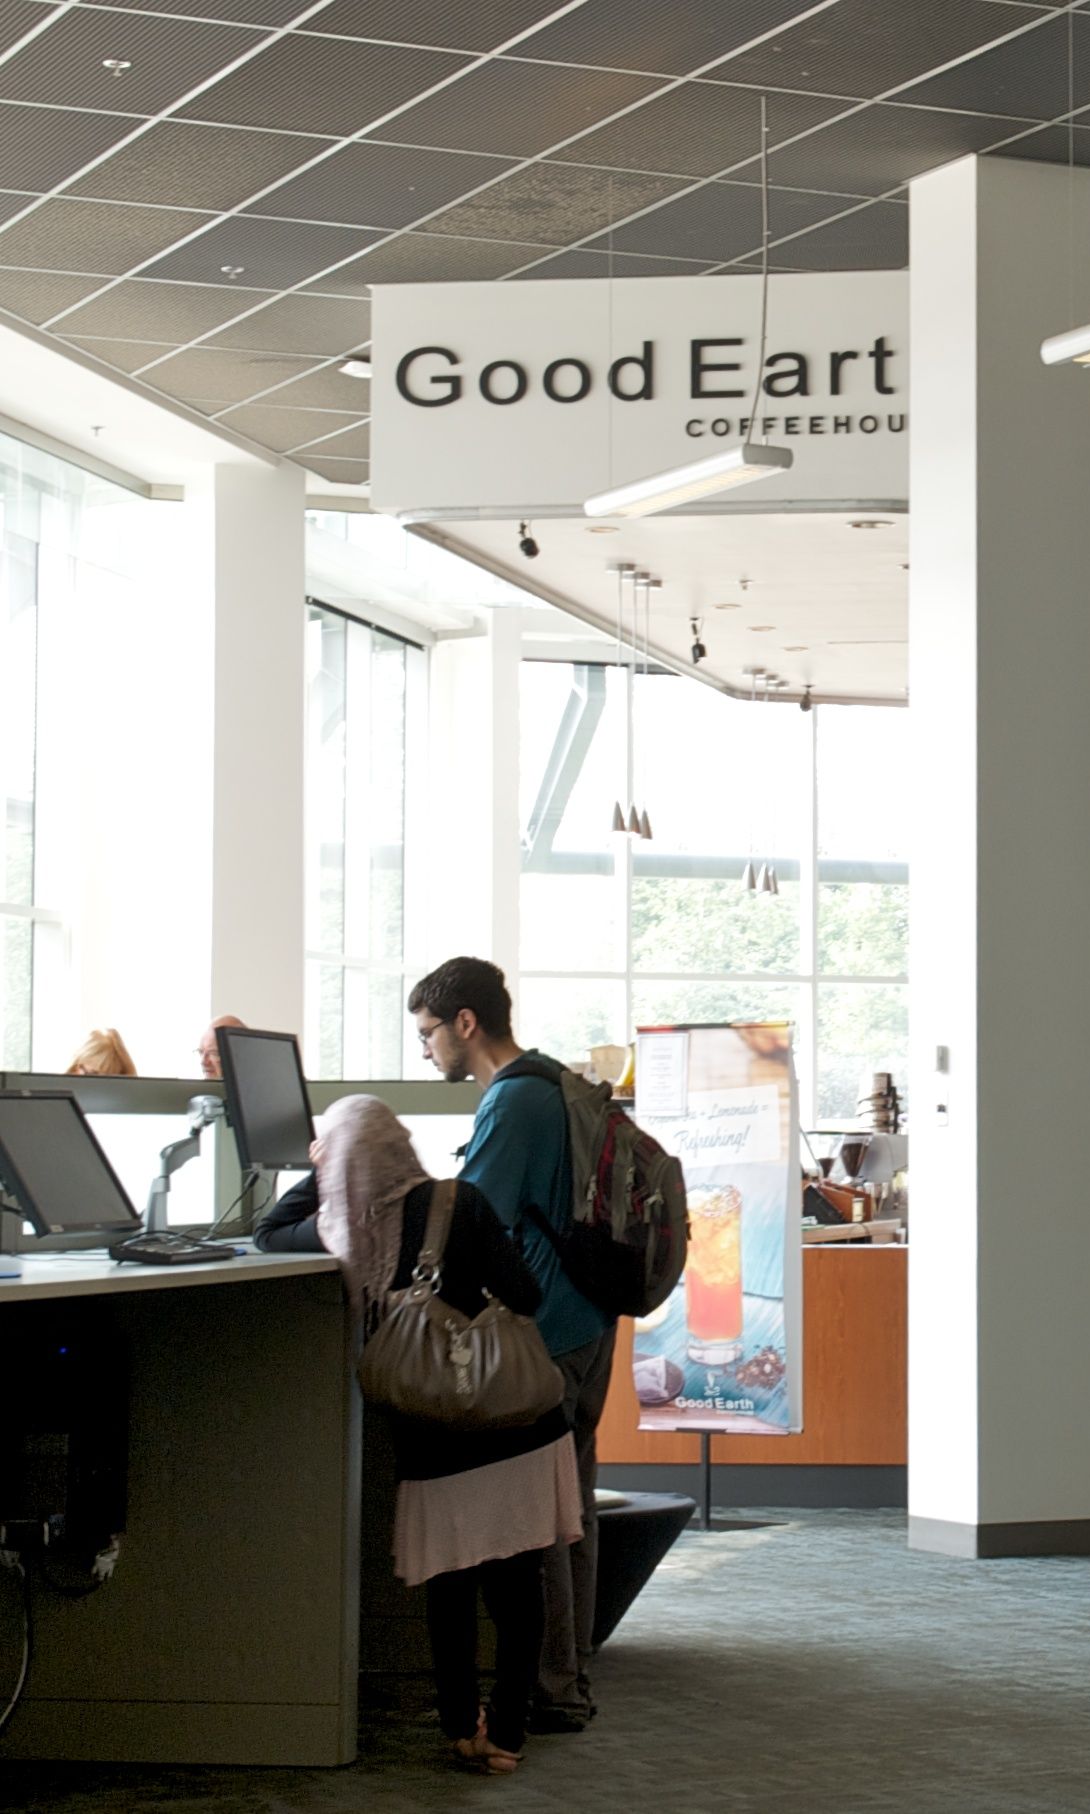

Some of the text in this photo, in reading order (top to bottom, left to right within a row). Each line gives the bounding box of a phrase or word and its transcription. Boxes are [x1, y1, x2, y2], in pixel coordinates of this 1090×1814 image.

[395, 336, 896, 408] Good Eart
[686, 413, 906, 437] COFFEEHOU
[675, 1396, 754, 1409] Good Earth
